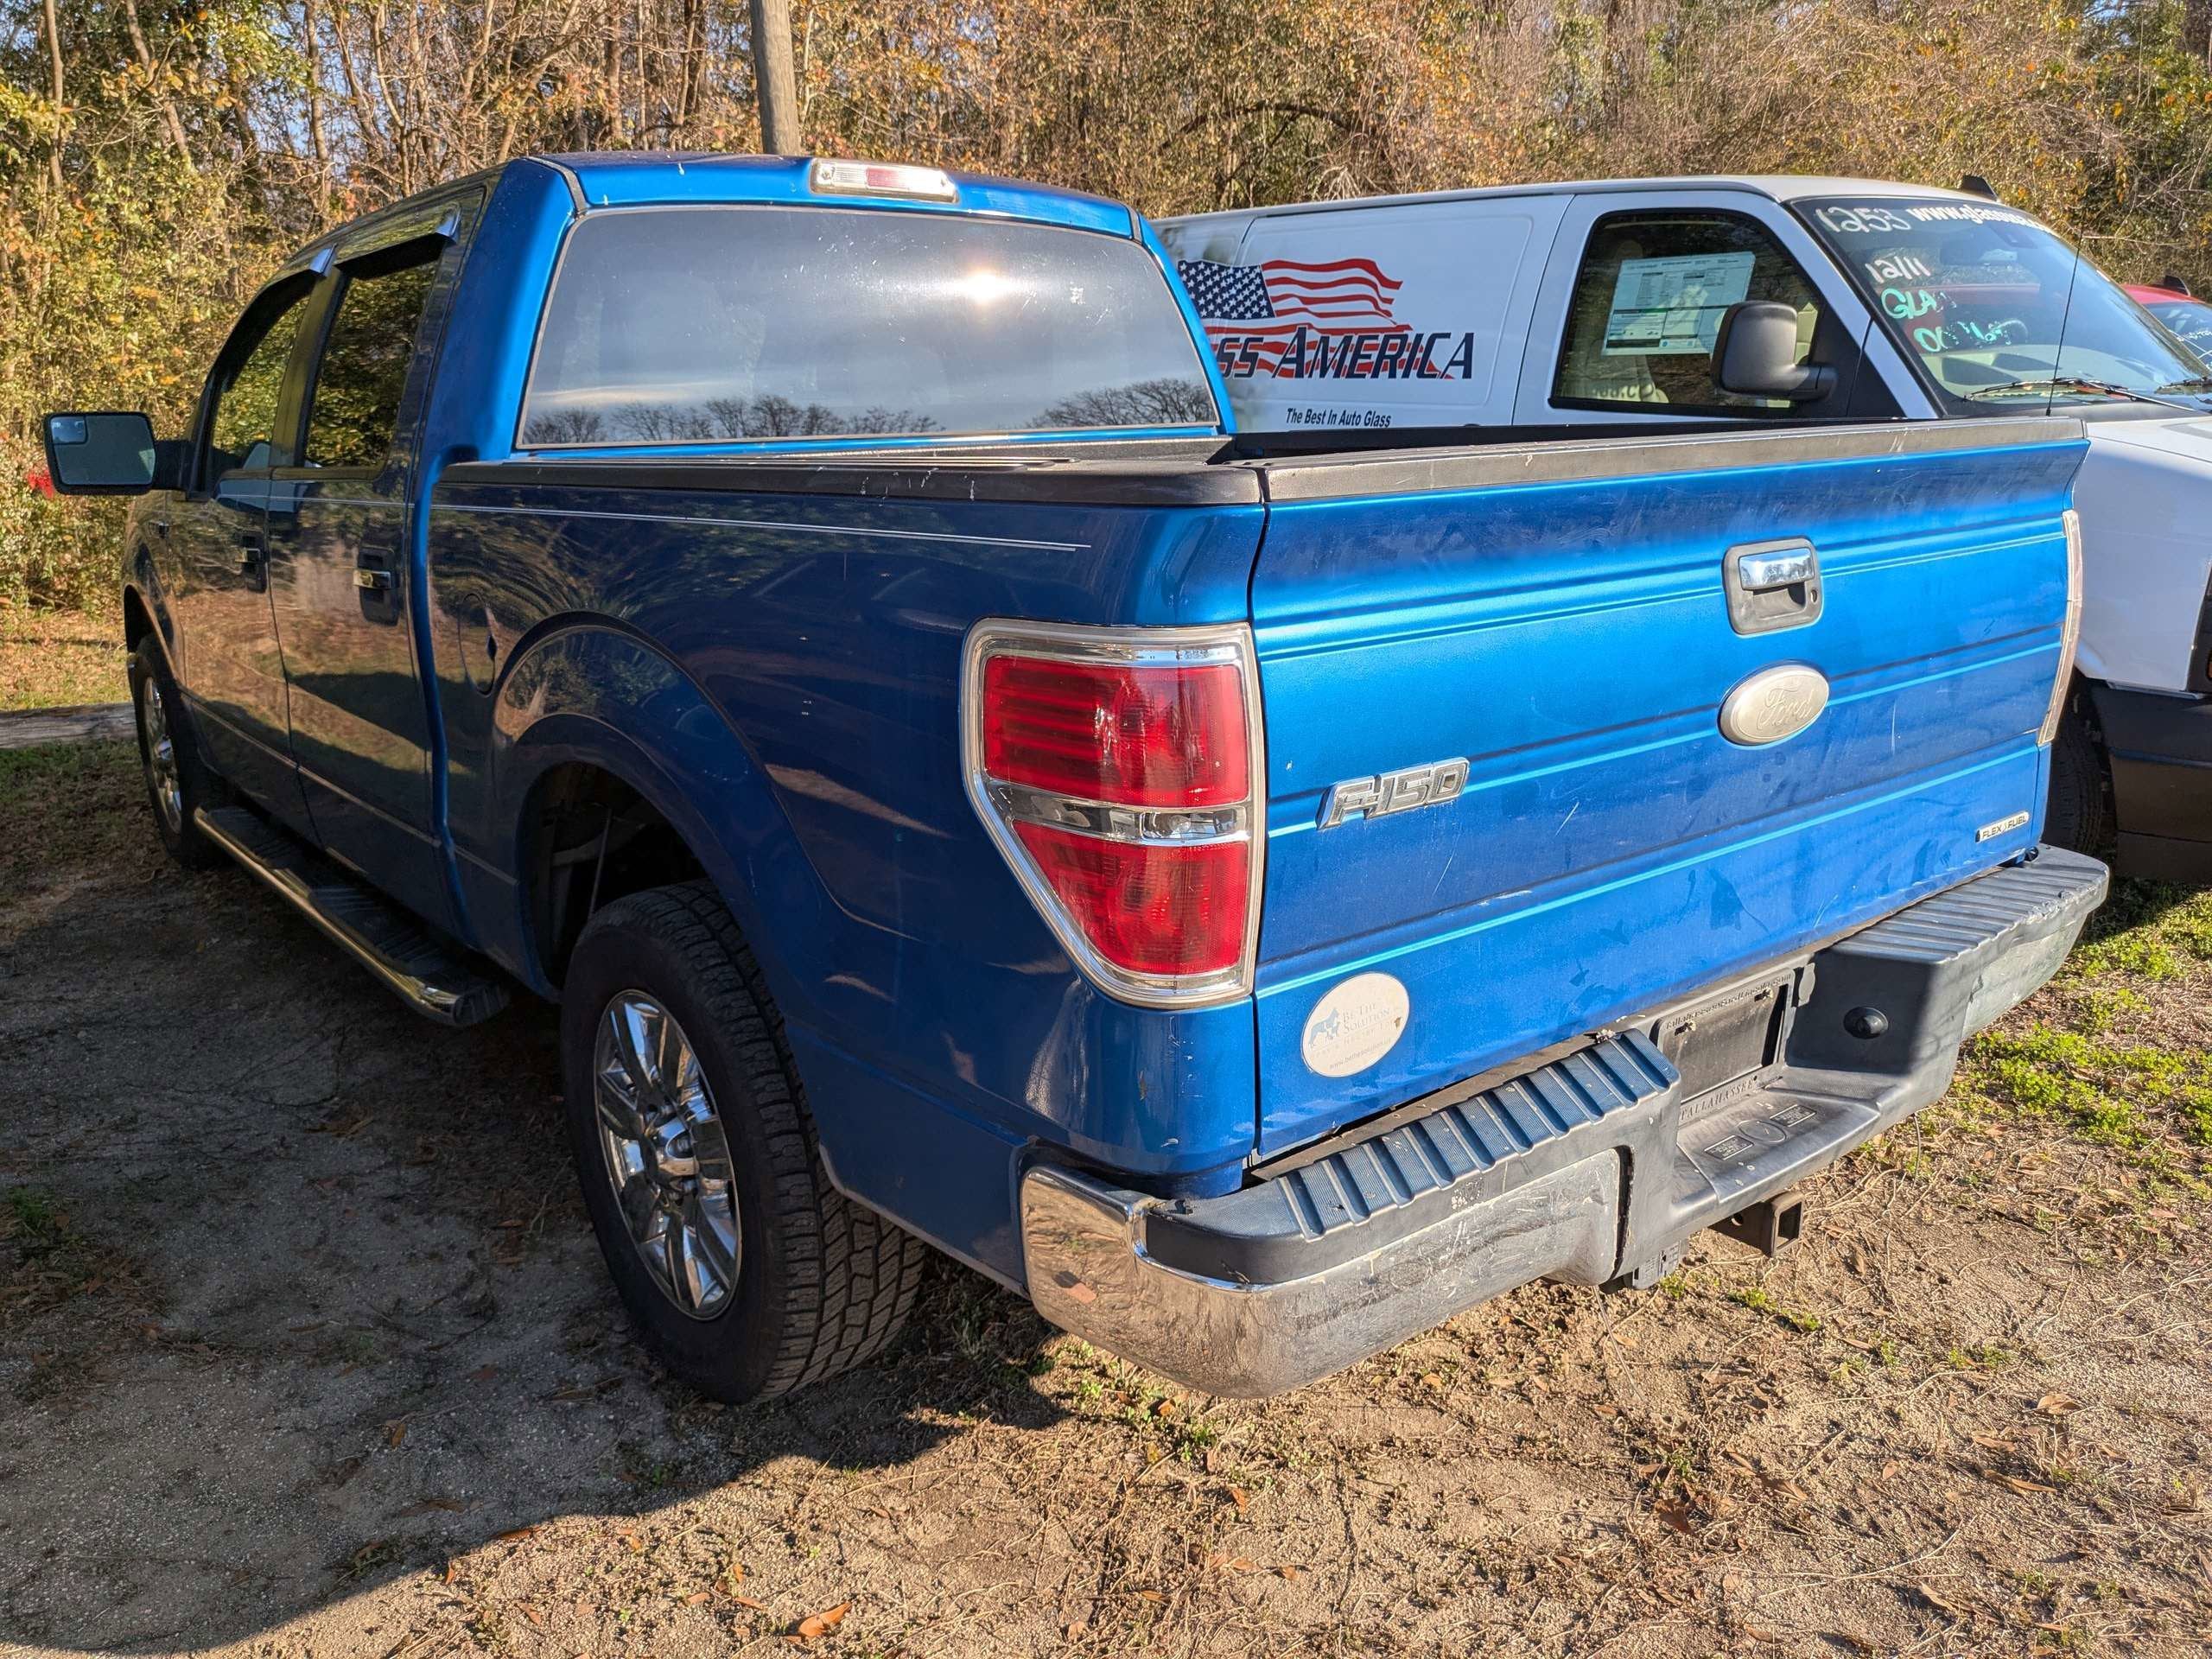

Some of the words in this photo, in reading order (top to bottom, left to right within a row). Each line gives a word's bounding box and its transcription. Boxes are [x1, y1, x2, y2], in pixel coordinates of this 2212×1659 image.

[1815, 207, 1912, 233] 1253
[1271, 327, 1475, 379] AMERICA
[1287, 407, 1303, 424] The
[1304, 408, 1326, 425] Best
[1327, 409, 1338, 425] In
[1338, 410, 1362, 426] Auto
[1363, 410, 1392, 428] Glass
[1756, 687, 1815, 732] Ford
[1315, 757, 1470, 830] F-150
[1981, 824, 2002, 839] FLEX
[2007, 815, 2025, 829] FUEL
